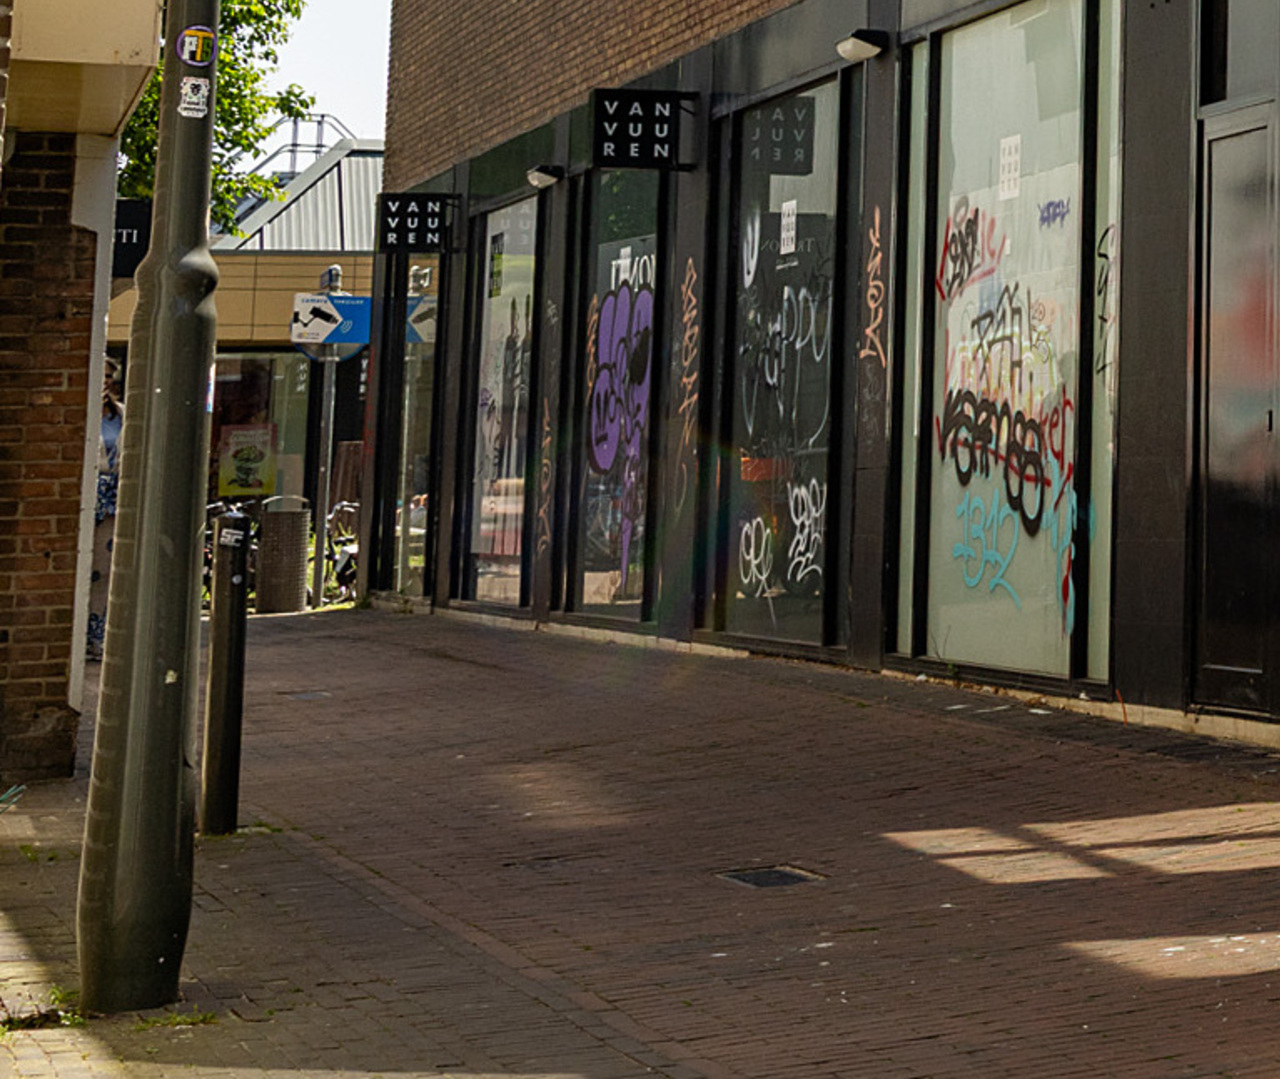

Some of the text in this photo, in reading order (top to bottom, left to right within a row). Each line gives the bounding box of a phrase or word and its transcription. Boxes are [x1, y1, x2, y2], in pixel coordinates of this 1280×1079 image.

[604, 100, 671, 117] VAN
[604, 122, 670, 138] VUU
[603, 142, 670, 158] REN
[387, 201, 441, 213] VAN
[387, 217, 440, 229] VUU
[387, 232, 440, 244] REN
